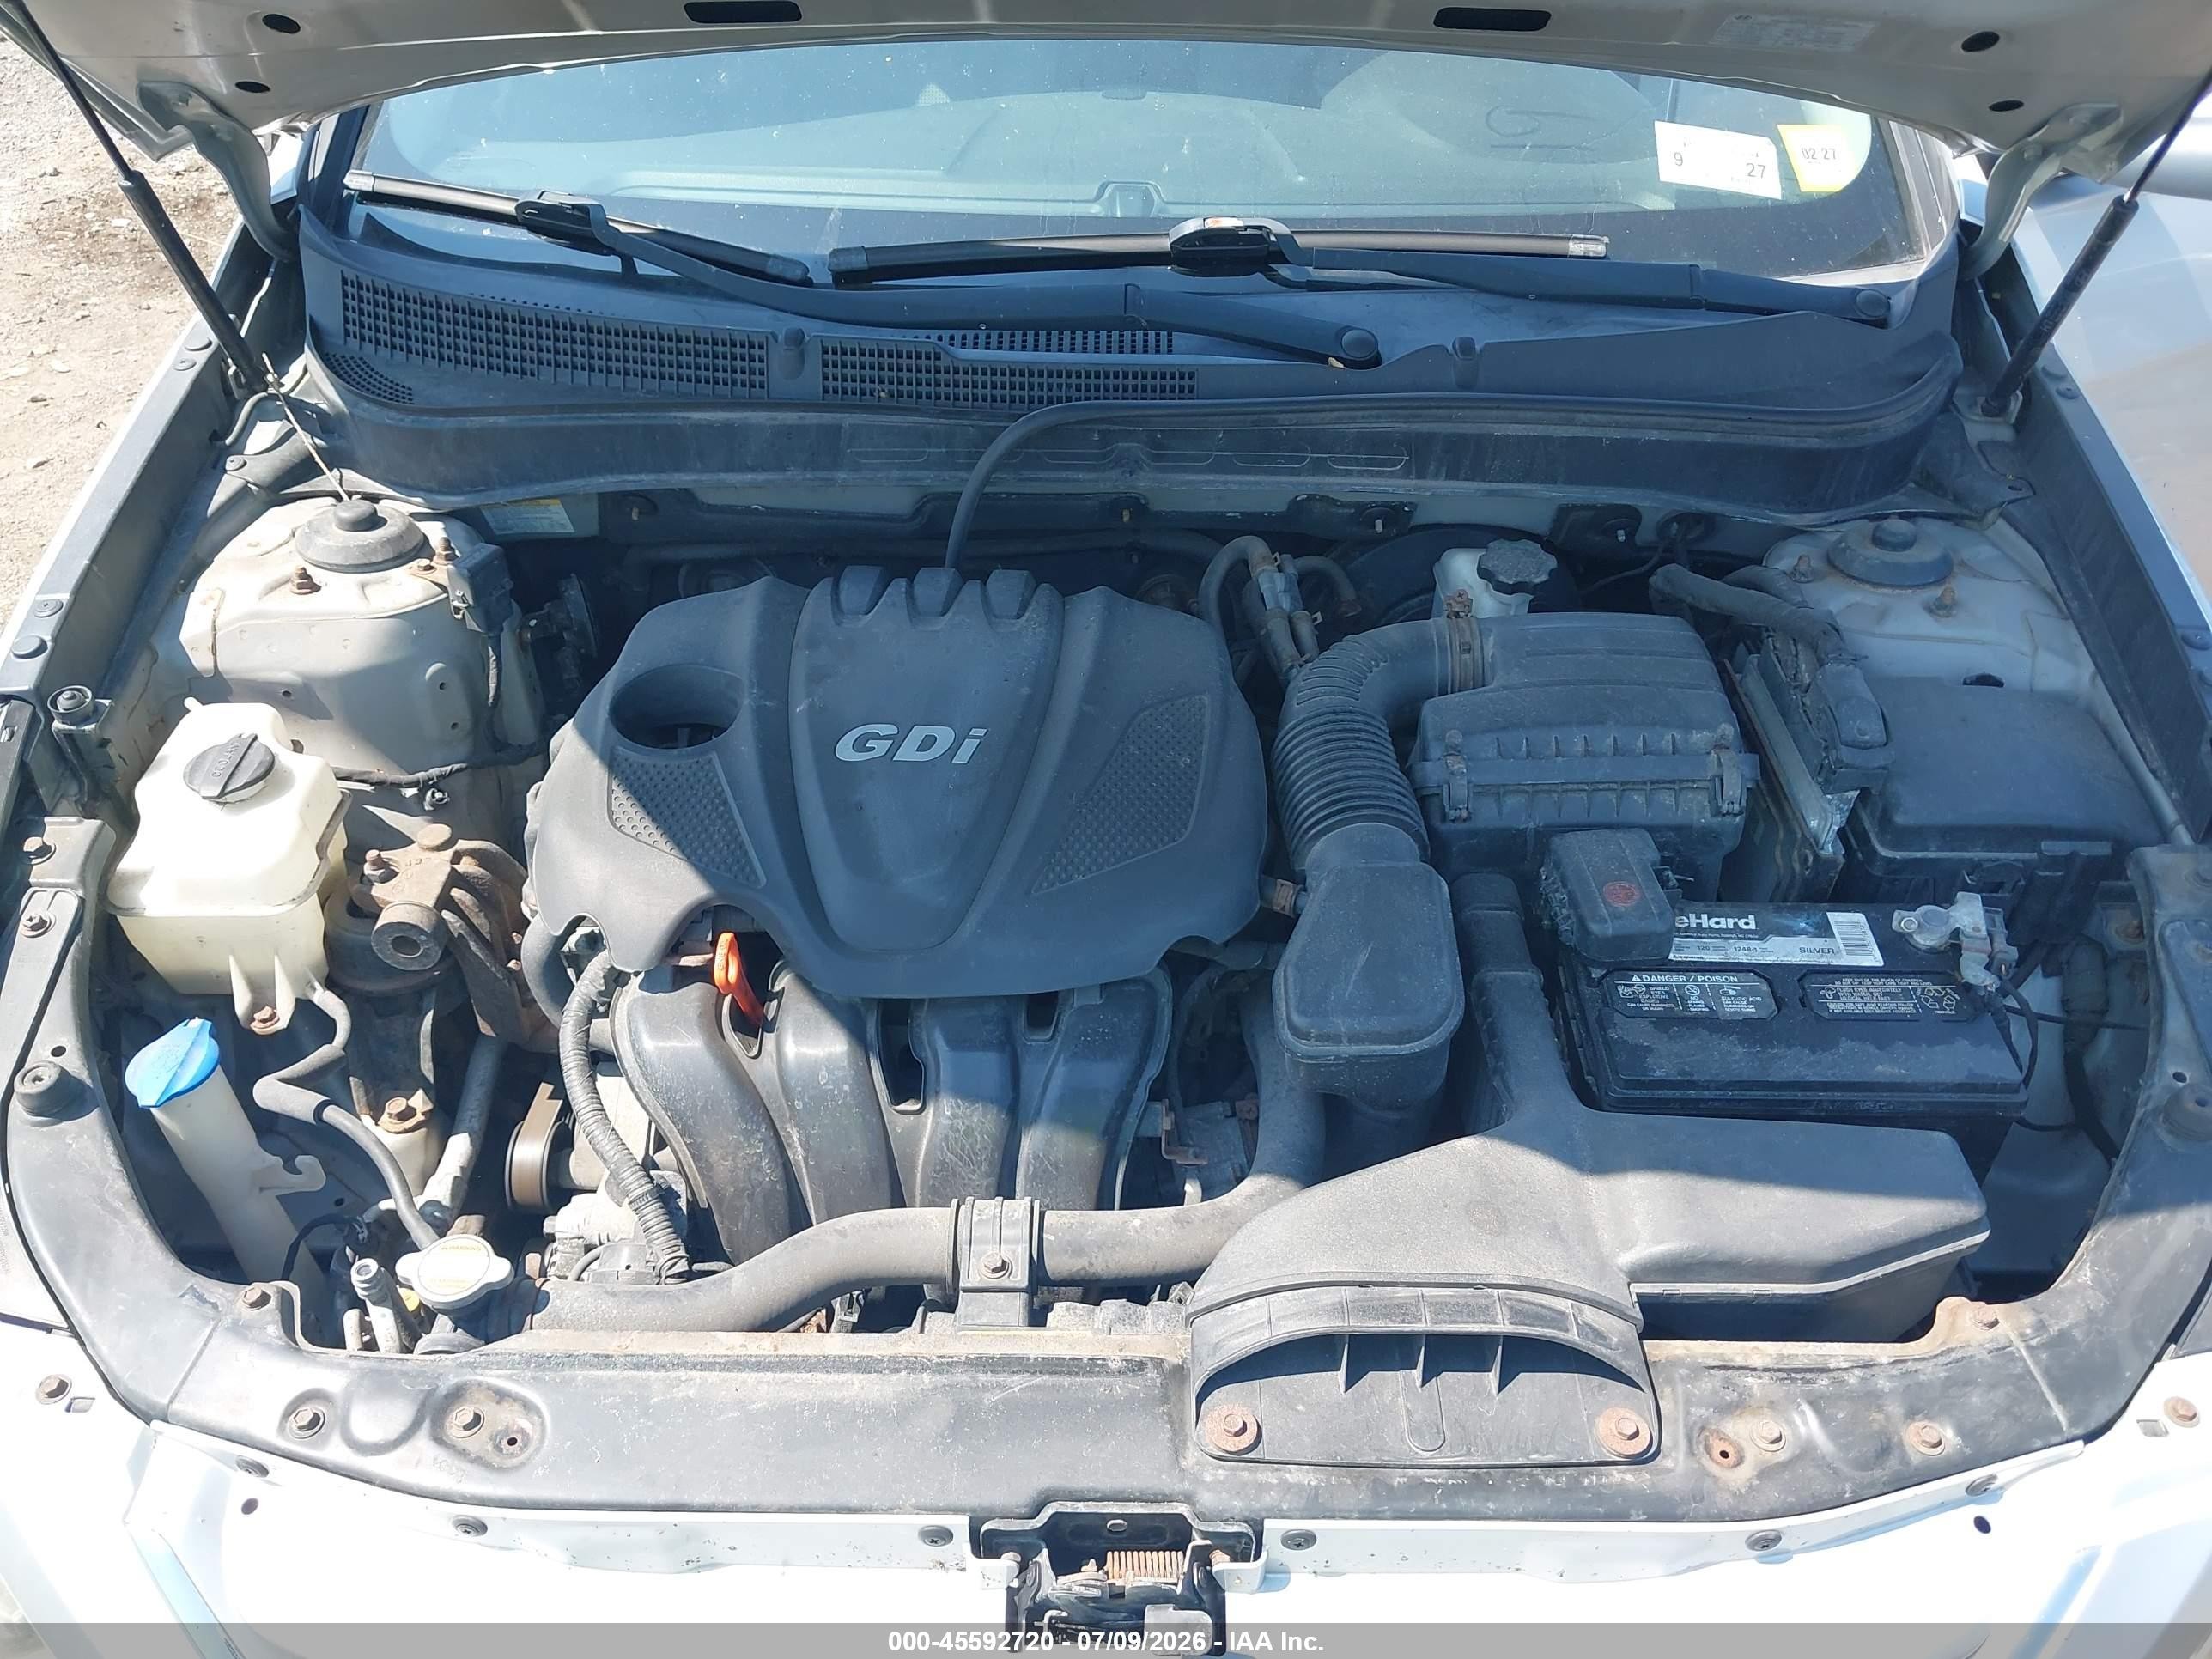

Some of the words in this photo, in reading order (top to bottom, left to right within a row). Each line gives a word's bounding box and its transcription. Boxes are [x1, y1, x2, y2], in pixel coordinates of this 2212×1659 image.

[1673, 151, 1684, 167] 9
[1746, 162, 1766, 179] 27
[835, 723, 988, 764] GDi
[1799, 946, 1835, 955] SILVER
